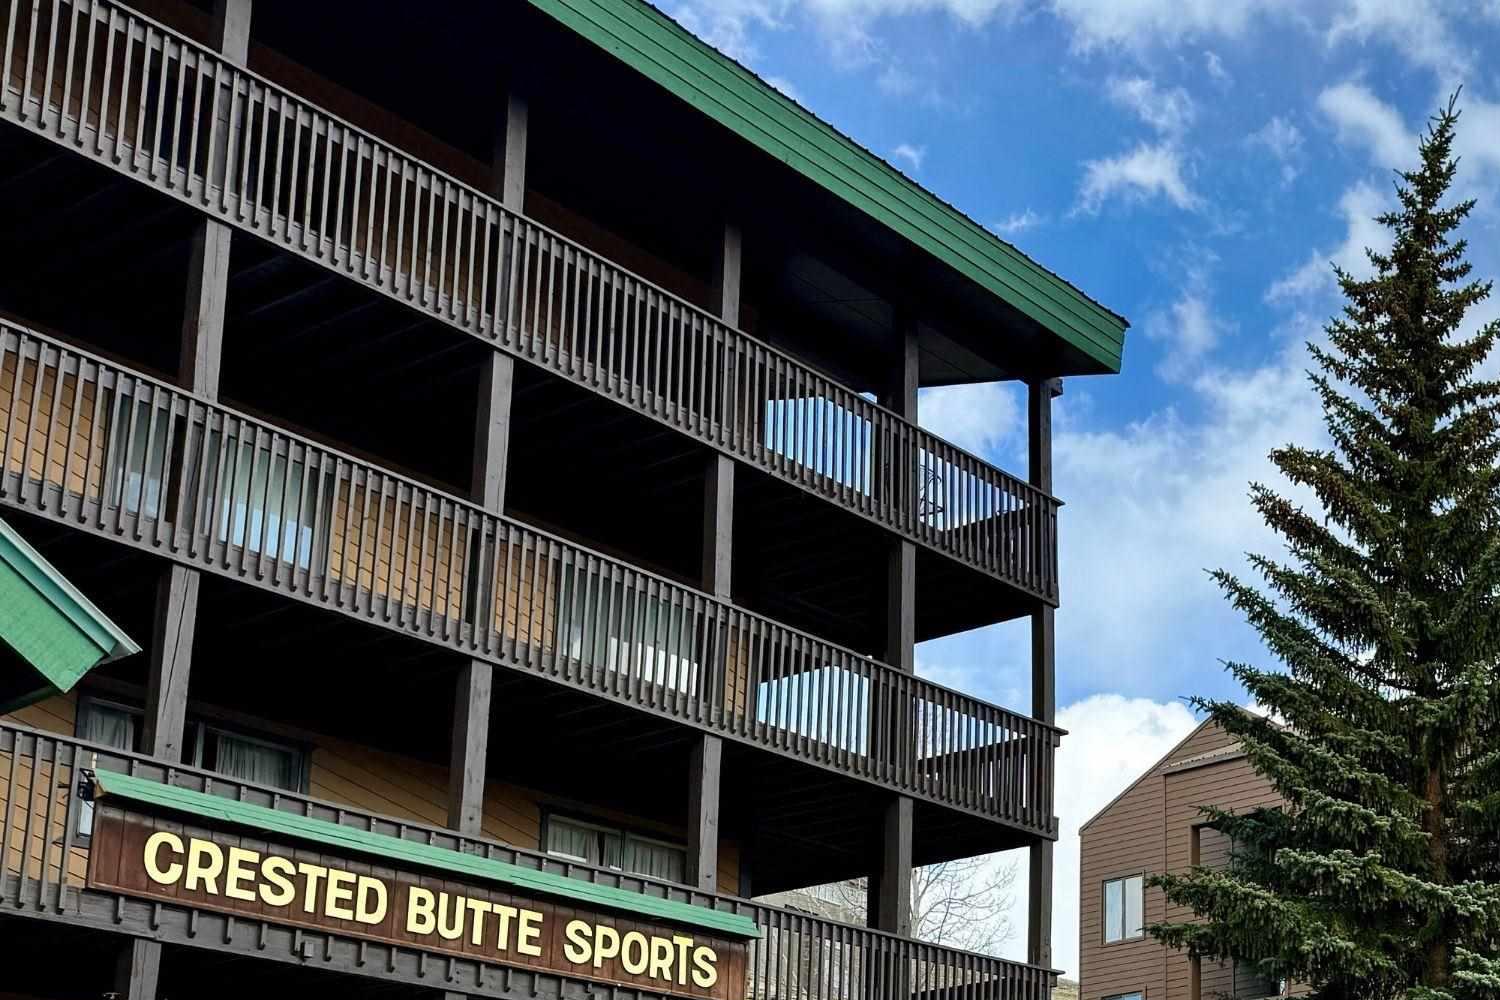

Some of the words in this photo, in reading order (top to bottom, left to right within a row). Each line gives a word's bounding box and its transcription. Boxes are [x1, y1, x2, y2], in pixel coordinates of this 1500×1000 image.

[143, 831, 388, 925] CRESTED
[406, 886, 543, 957] BUTTE
[563, 919, 718, 988] SPORTS
